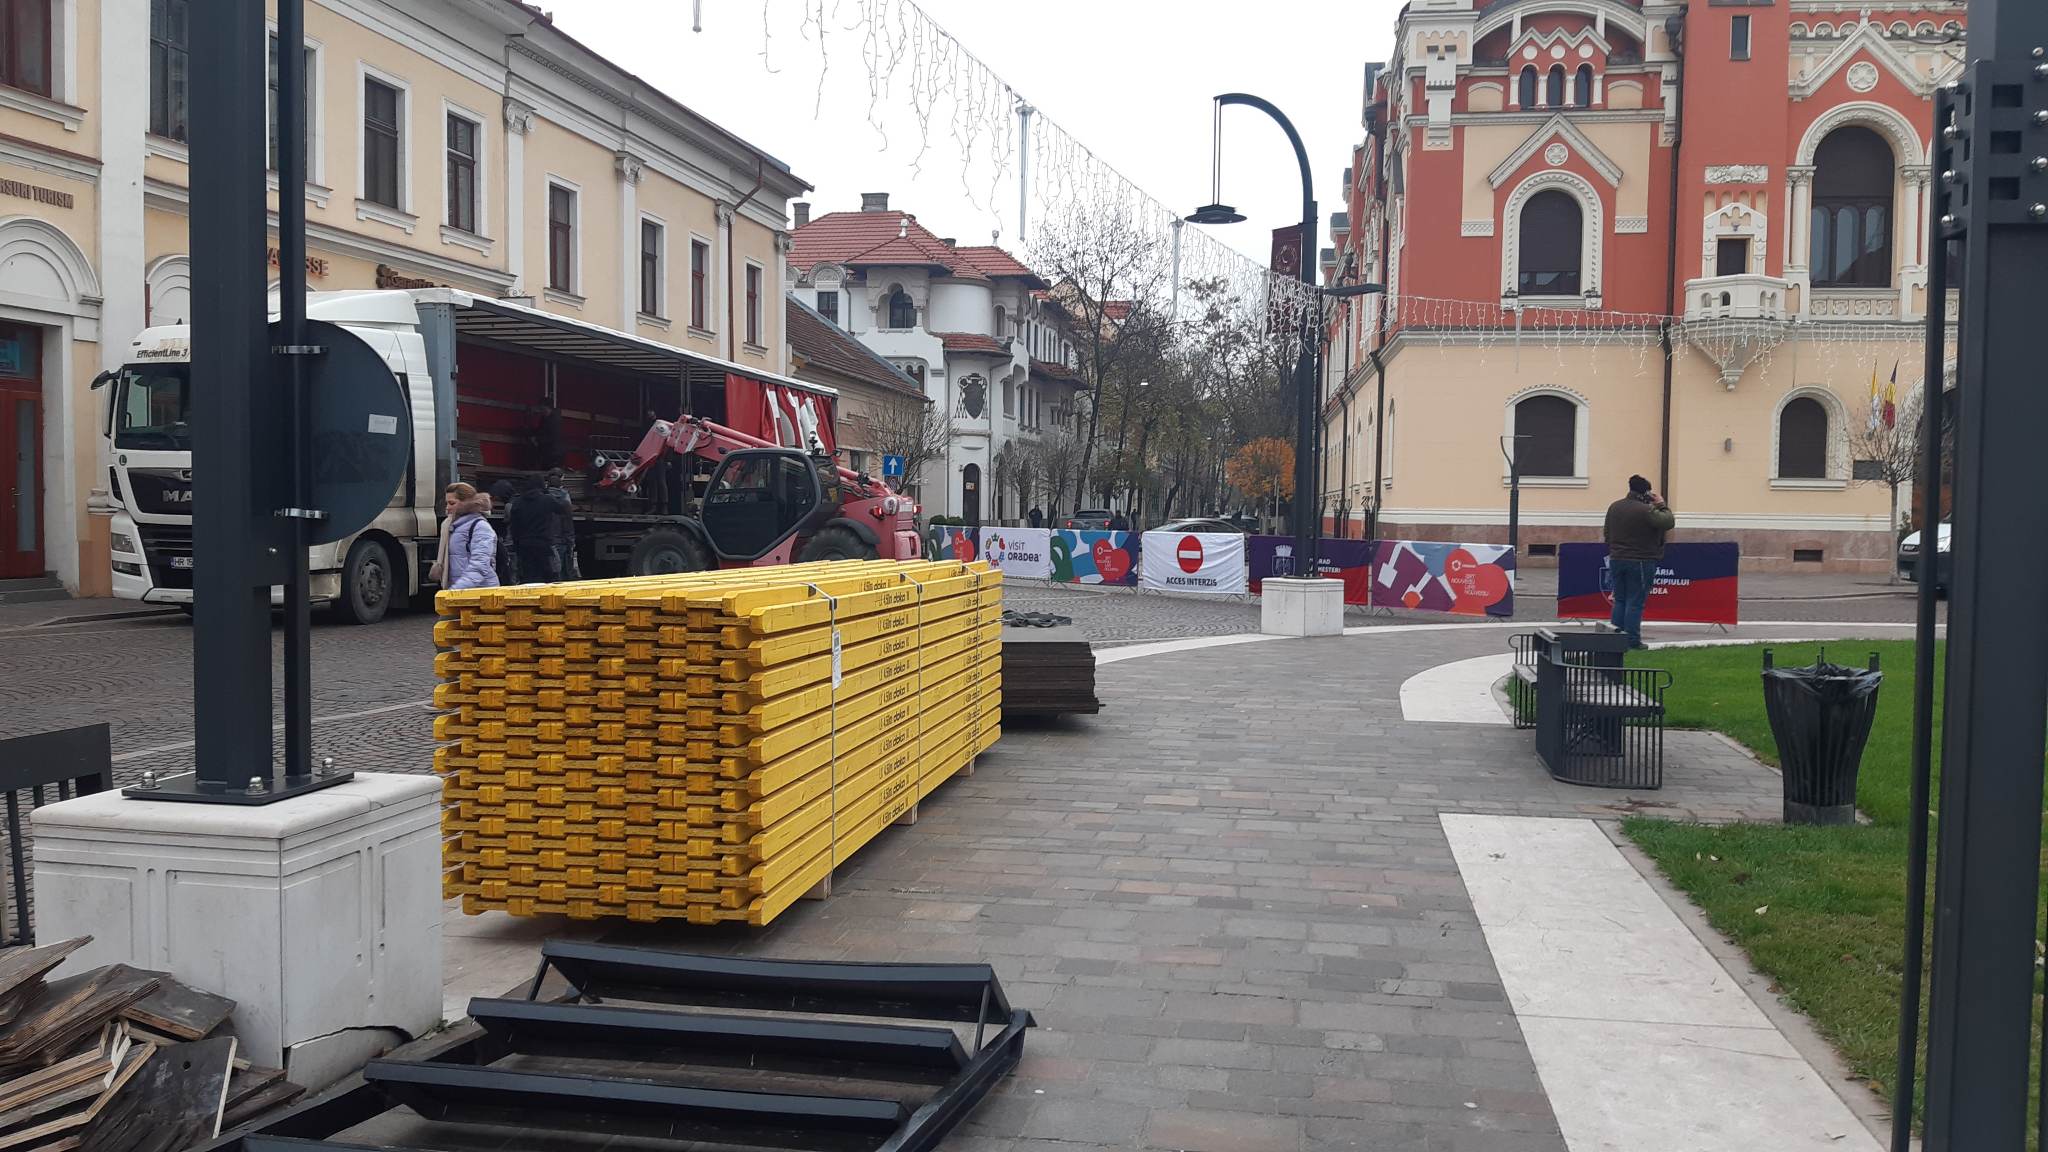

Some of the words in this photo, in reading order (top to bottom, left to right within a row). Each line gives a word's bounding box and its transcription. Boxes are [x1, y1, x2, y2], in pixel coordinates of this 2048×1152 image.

[32, 186, 74, 209] TURISM
[136, 349, 181, 359] EfficientLine
[162, 490, 192, 502] MA
[1165, 576, 1186, 585] ACCES
[1186, 577, 1218, 587] INTERZIS
